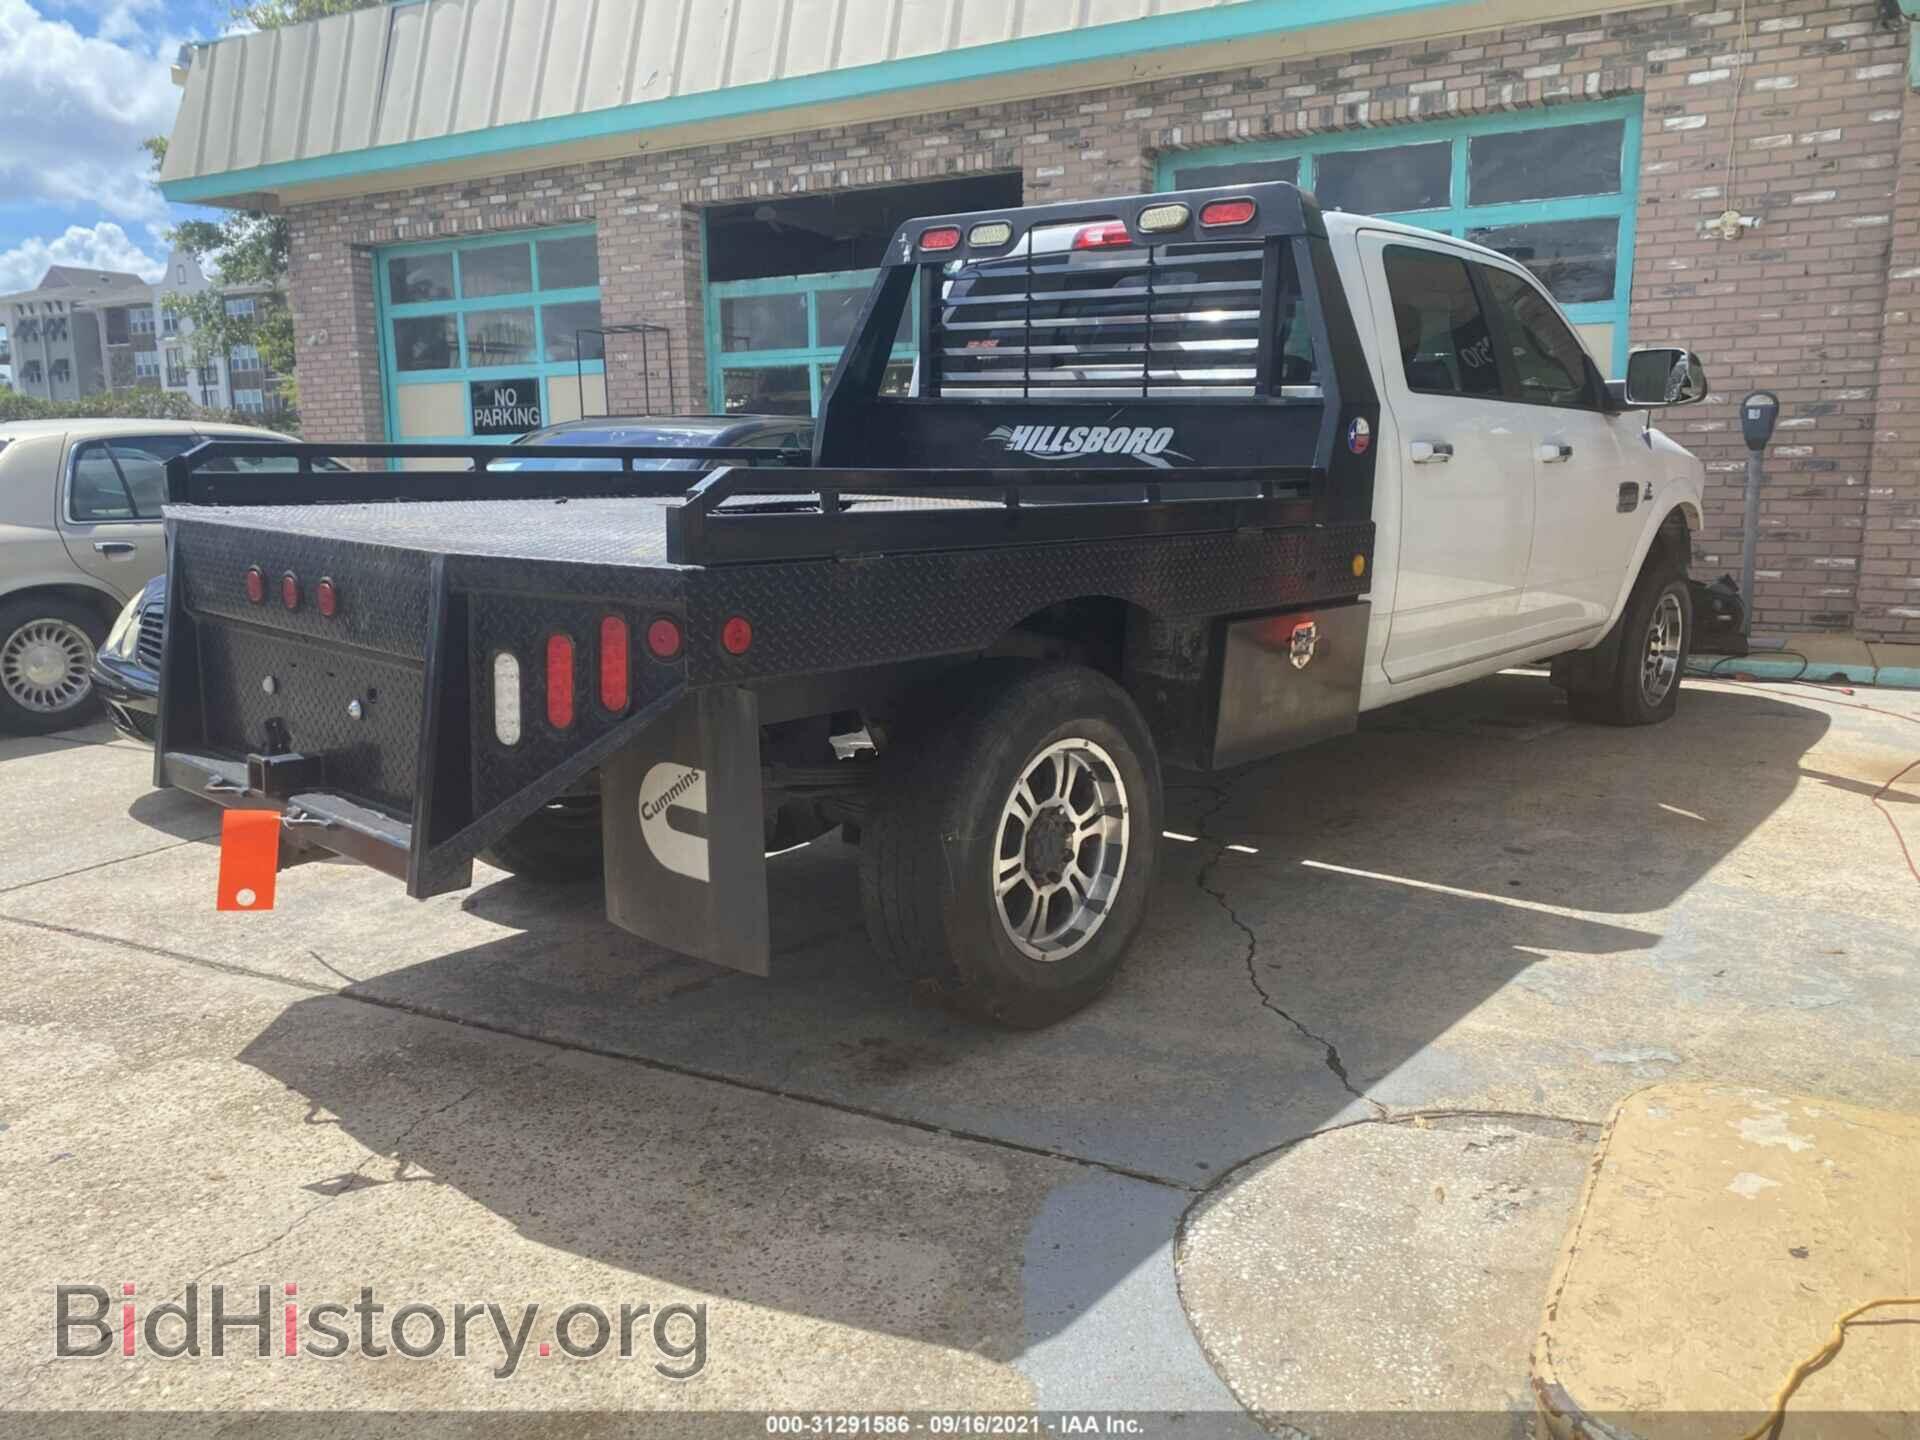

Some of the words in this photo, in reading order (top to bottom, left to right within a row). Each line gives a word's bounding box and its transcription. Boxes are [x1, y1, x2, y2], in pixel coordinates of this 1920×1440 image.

[494, 388, 517, 406] NO
[474, 407, 540, 426] PARKING
[1004, 425, 1175, 454] HILLSBORO
[641, 768, 700, 820] Cummins
